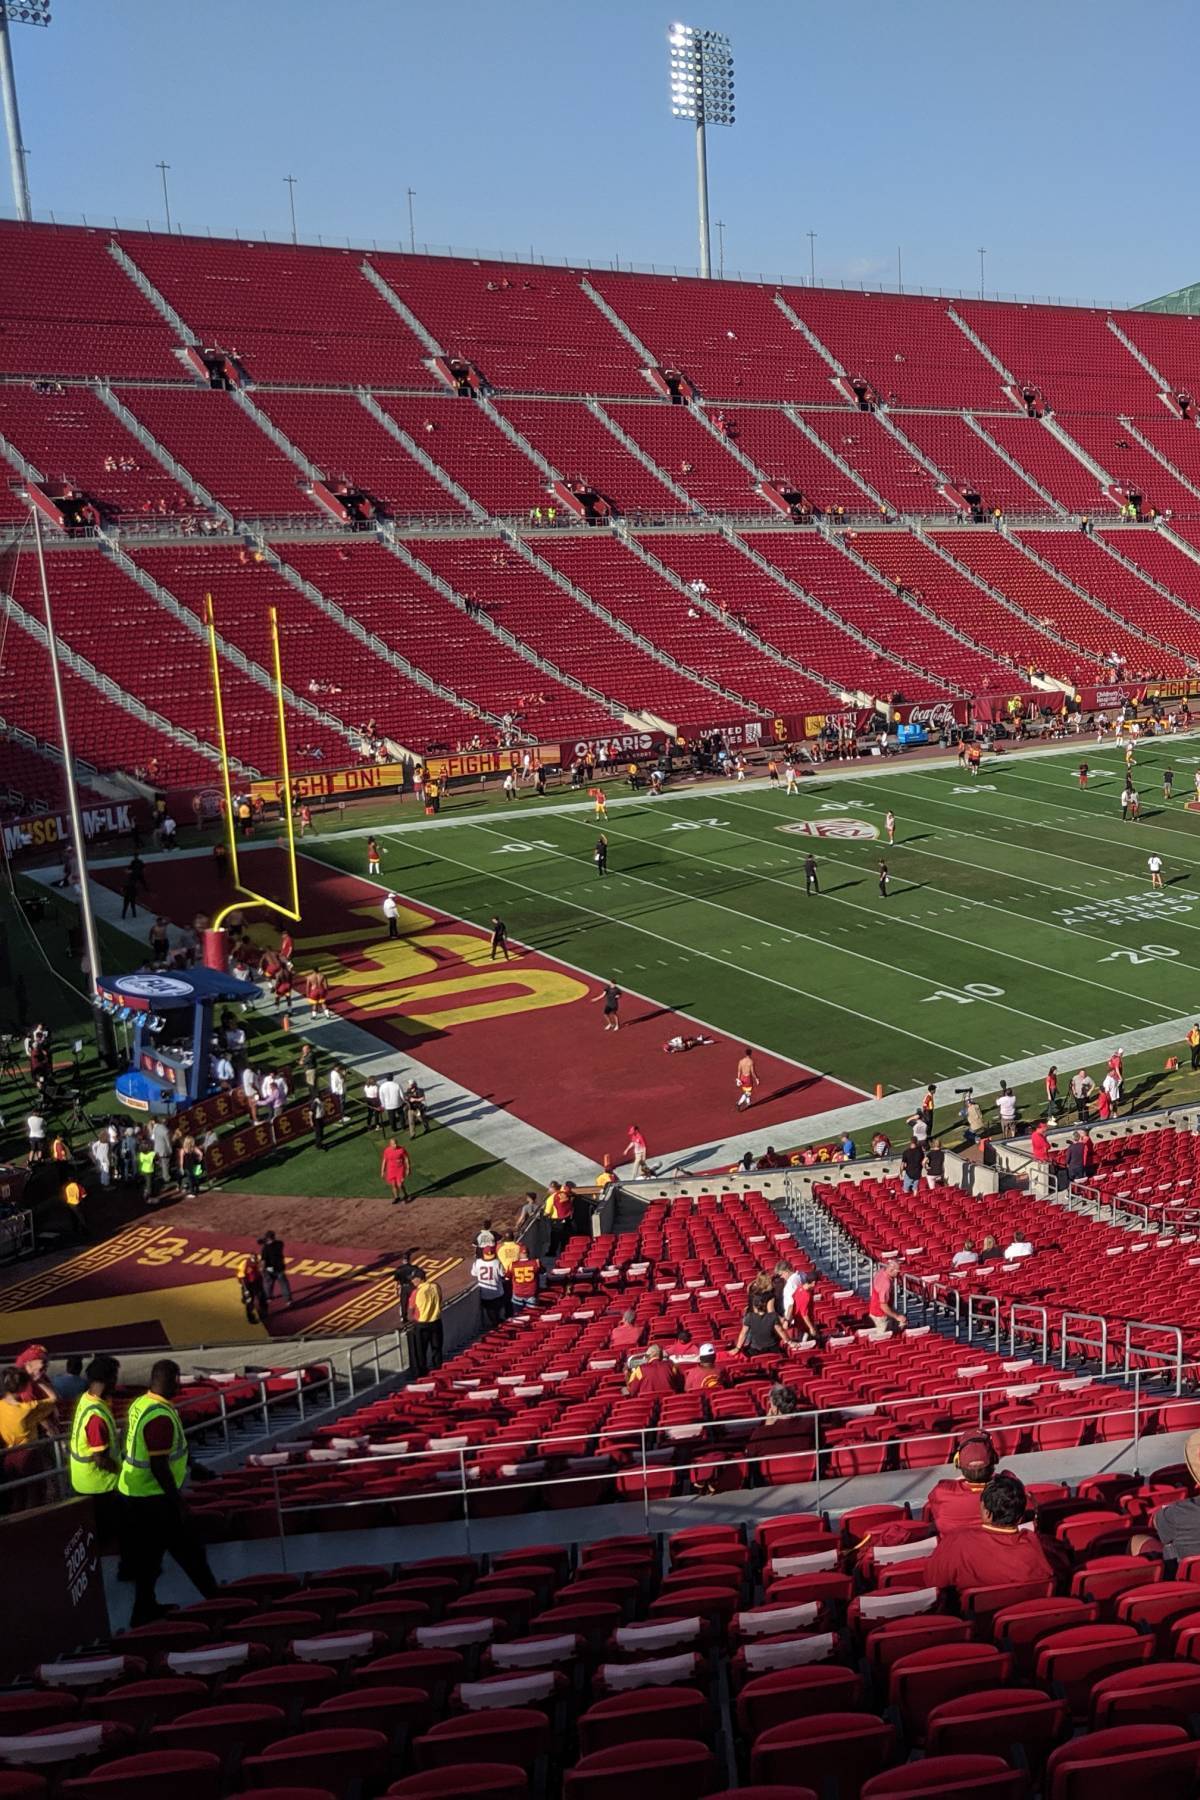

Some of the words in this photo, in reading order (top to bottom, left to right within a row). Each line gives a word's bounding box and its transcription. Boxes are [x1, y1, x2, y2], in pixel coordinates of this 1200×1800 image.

[1159, 680, 1191, 697] FIGHT
[274, 774, 338, 798] FGHT
[345, 768, 381, 790] ON!
[1051, 891, 1165, 916] UNITED
[1062, 894, 1200, 925] AIRLINES
[1106, 905, 1193, 926] FIELD
[1110, 944, 1181, 965] 20
[934, 982, 1006, 1004] 10
[480, 1266, 494, 1281] 21
[514, 1266, 535, 1283] 55
